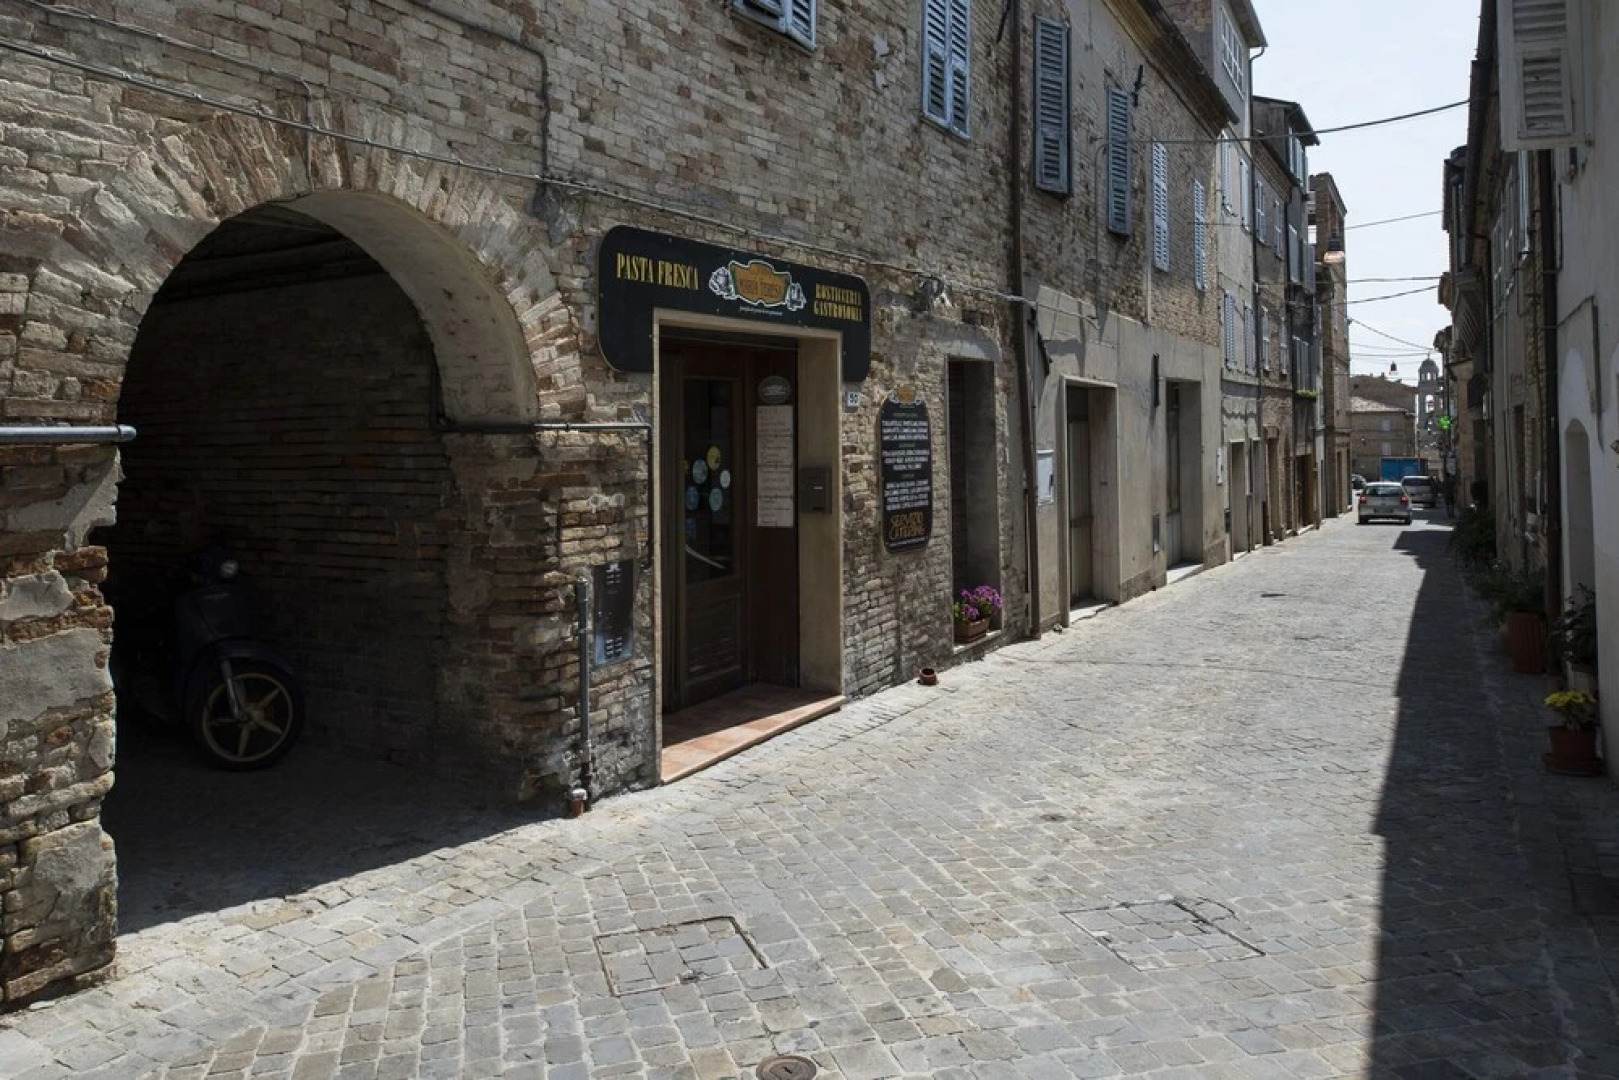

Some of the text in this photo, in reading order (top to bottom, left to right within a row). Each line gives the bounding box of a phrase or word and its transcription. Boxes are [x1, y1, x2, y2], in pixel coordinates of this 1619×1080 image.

[616, 252, 699, 290] PASTA FRESCA
[813, 300, 862, 322] GASTRONOMIA
